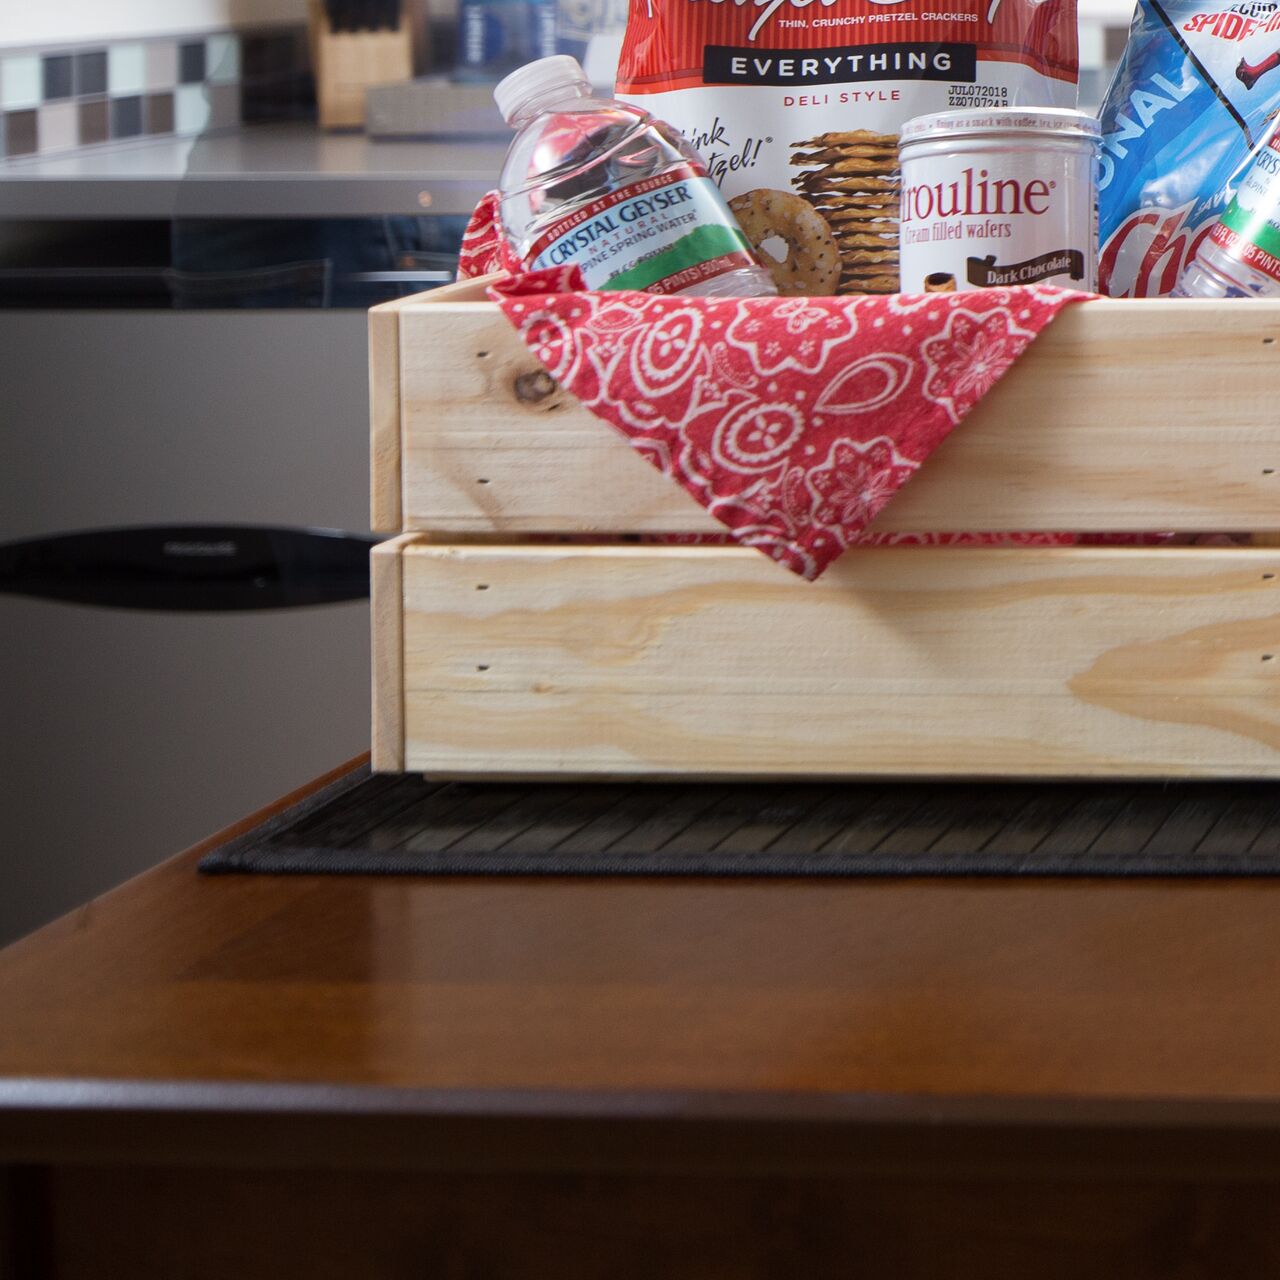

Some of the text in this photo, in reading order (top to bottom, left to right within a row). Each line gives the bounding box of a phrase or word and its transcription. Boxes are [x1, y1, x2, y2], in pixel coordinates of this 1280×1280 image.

[779, 12, 979, 29] THIN, CRUNCHY PRETZEL CRACKERS
[731, 52, 952, 77] EVERYTHING
[784, 90, 901, 106] DELI STYLE
[948, 85, 1008, 97] JUL072018
[547, 174, 674, 241] BOTTLED AT THE SOURCE
[549, 184, 693, 266] CRYSTAL GEYSER
[588, 213, 669, 255] NATURAL
[611, 227, 657, 257] SPRING
[656, 209, 698, 236] WATER
[932, 220, 962, 241] filled
[966, 220, 1012, 238] wafers
[986, 256, 1072, 285] Dark Chocolate
